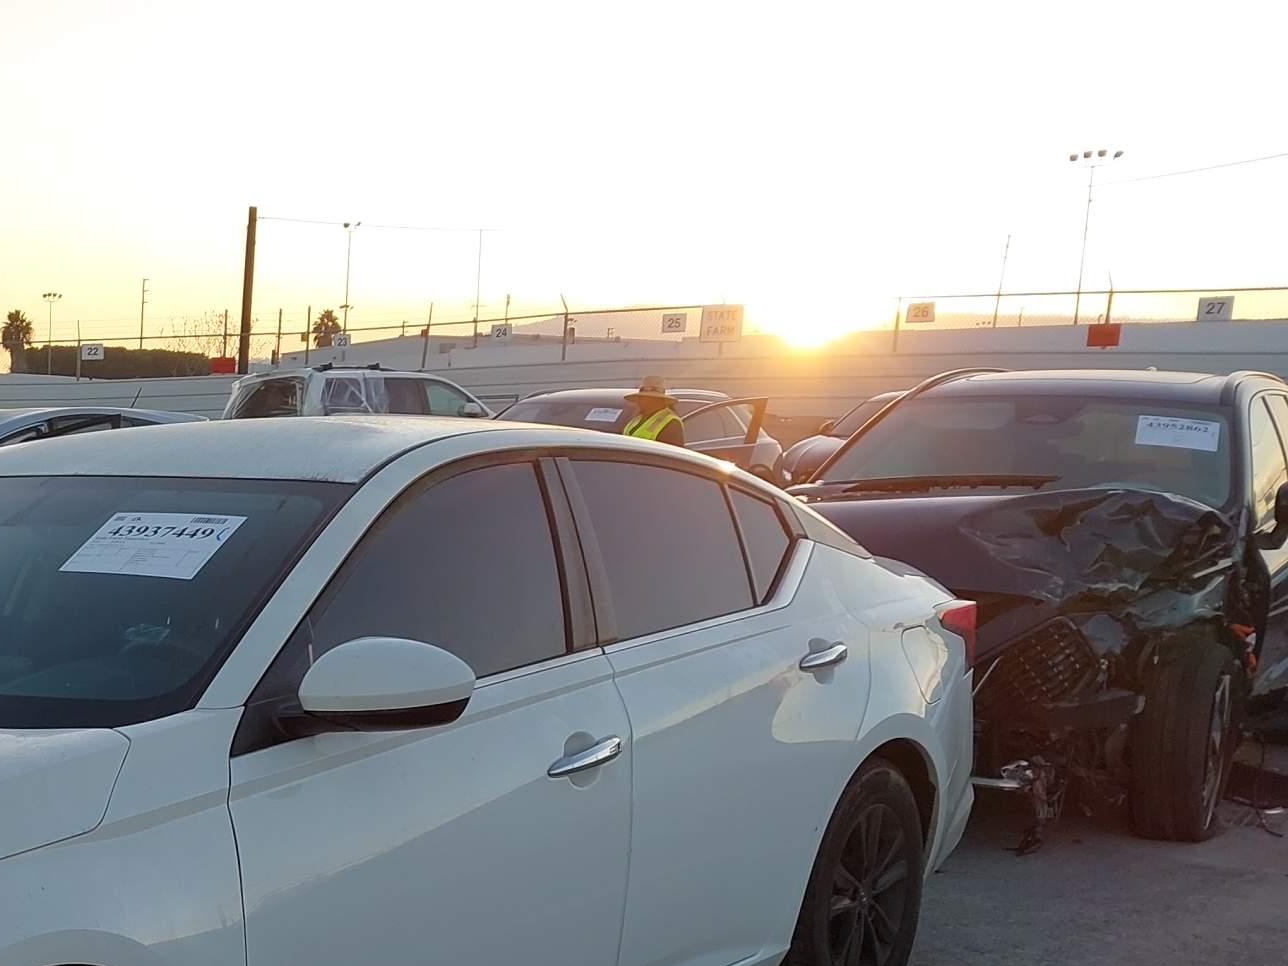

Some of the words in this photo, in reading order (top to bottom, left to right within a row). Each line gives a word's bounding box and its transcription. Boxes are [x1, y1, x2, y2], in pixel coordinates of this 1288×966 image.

[913, 306, 929, 318] 26
[1206, 302, 1225, 315] 27
[706, 310, 737, 321] STATE
[668, 318, 681, 329] 25
[496, 328, 507, 338] 24
[706, 326, 735, 337] FARM
[337, 337, 347, 347] 23
[87, 347, 99, 356] 22
[1146, 421, 1209, 434] 43952862
[107, 524, 215, 540] 43937449
